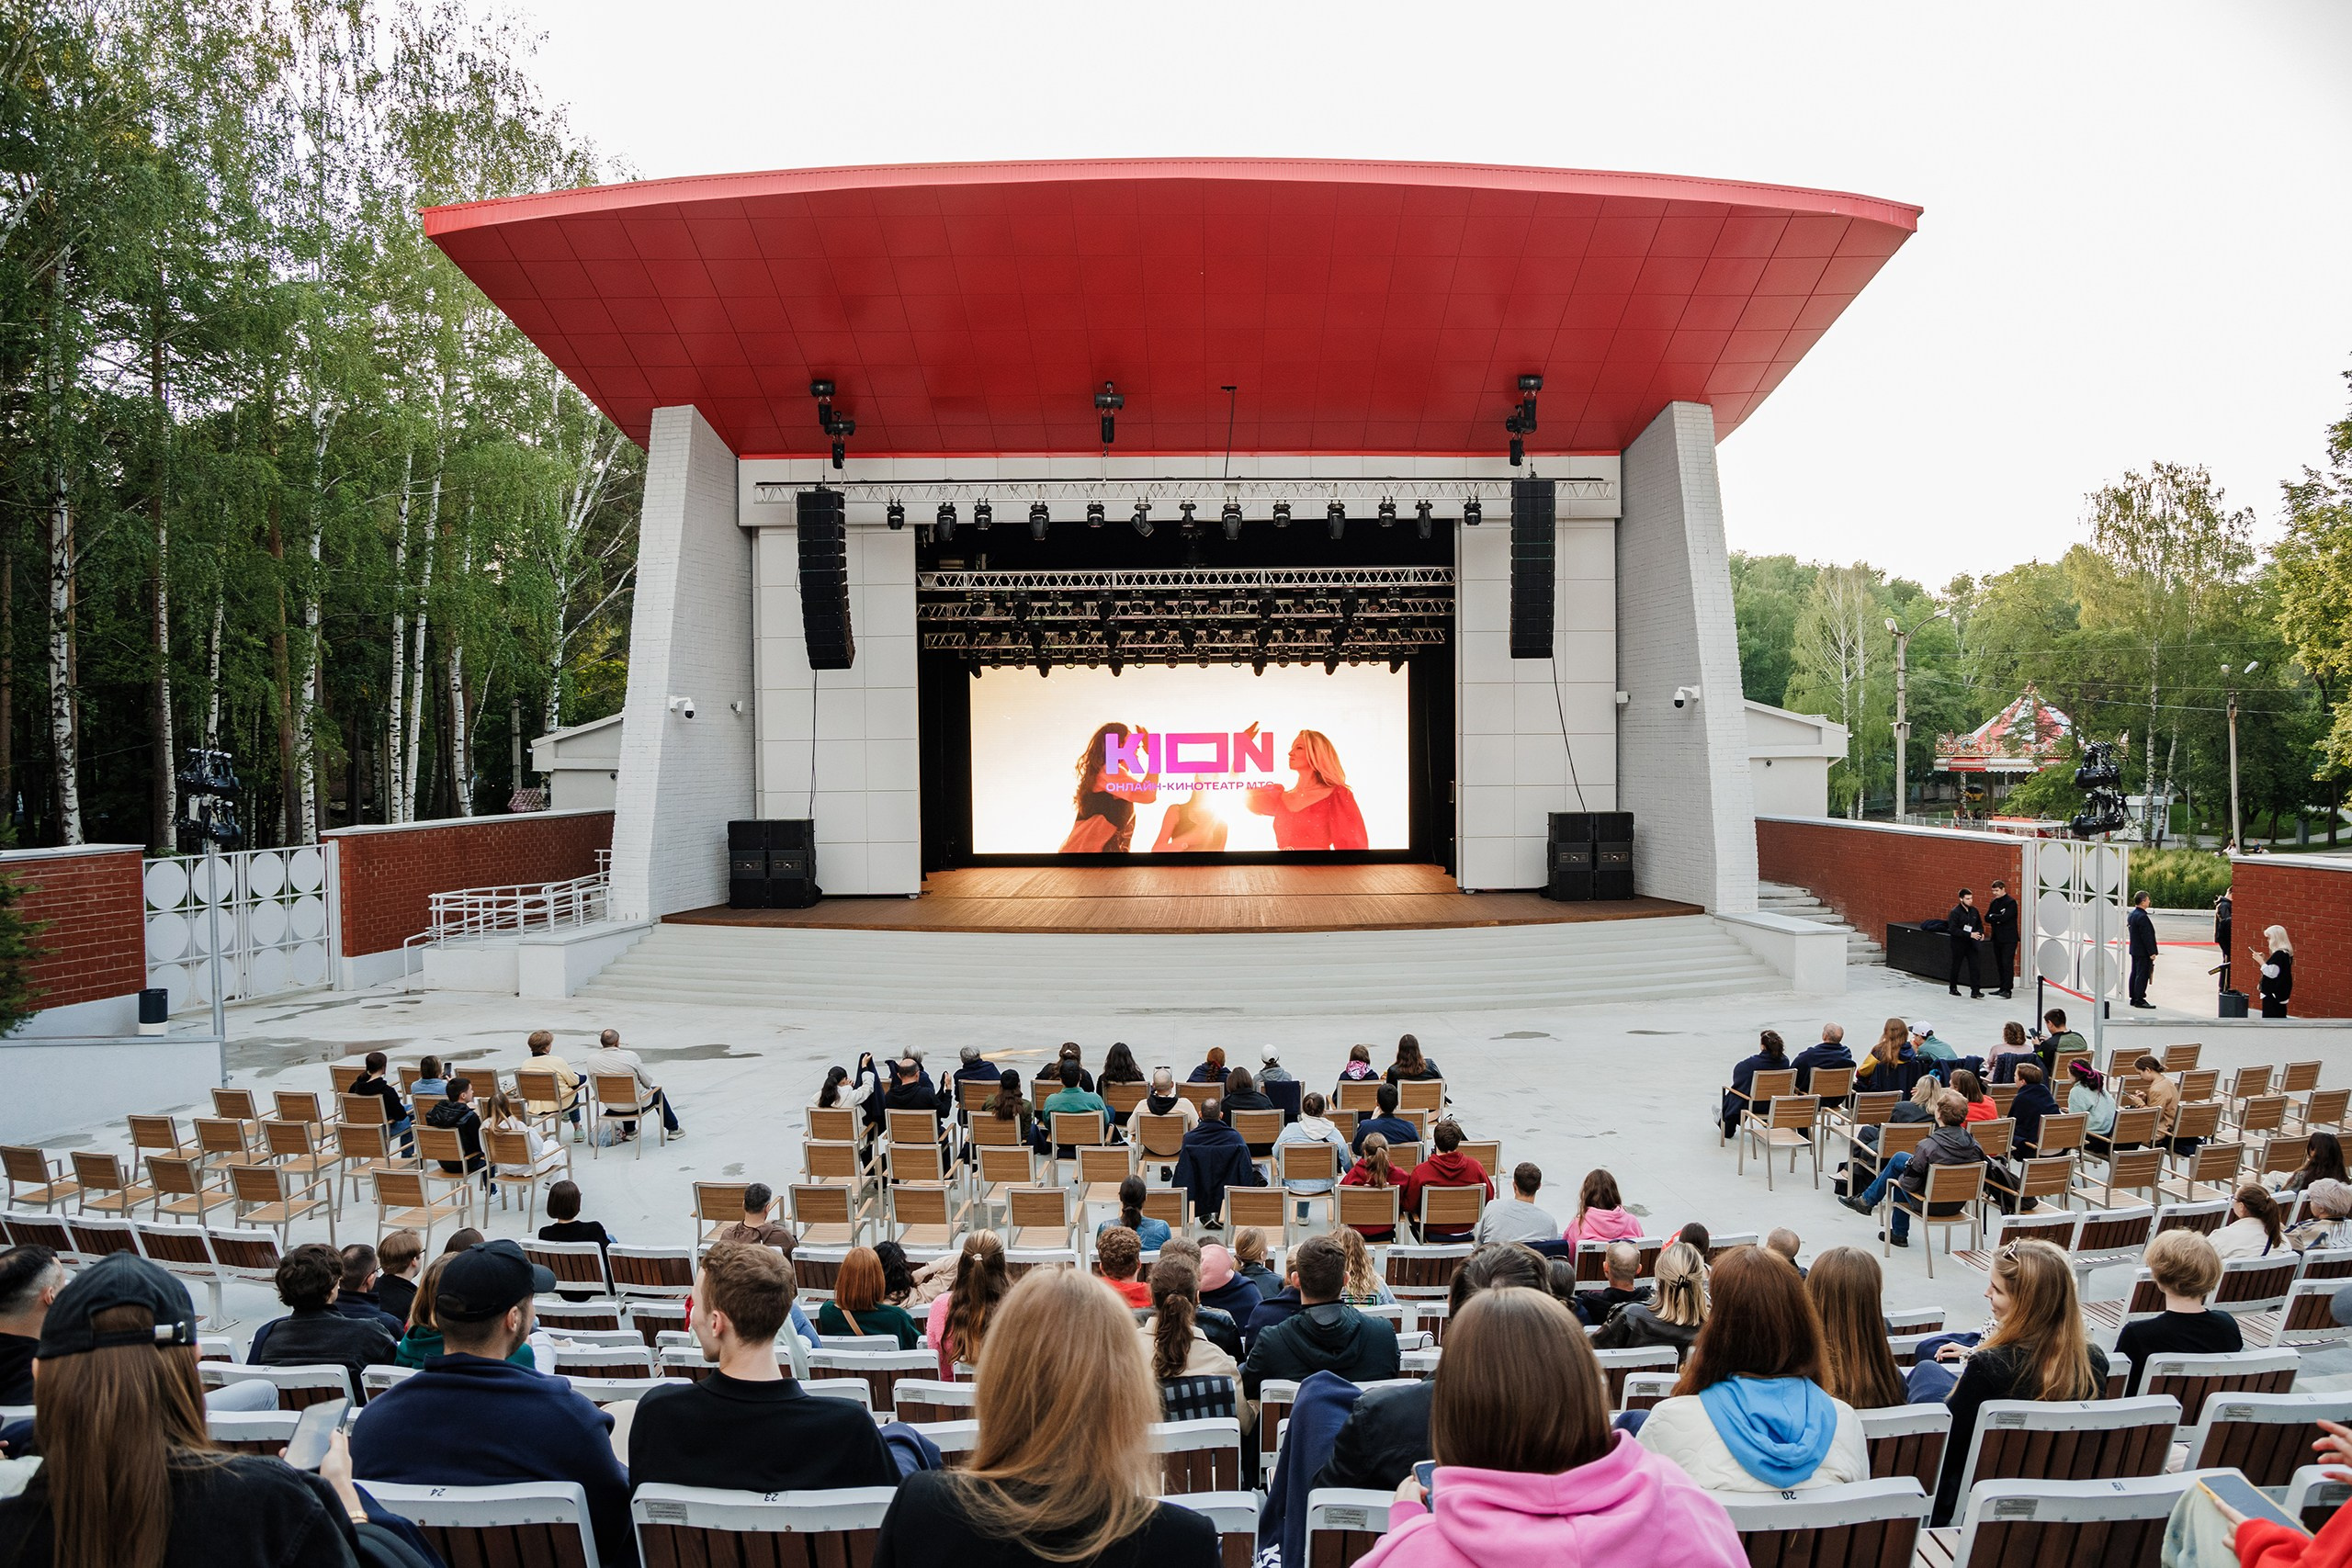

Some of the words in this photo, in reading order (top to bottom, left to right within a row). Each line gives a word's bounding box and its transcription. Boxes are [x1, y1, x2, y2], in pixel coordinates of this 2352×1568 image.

[1105, 732, 1274, 773] KION
[1105, 781, 1244, 792] ОНЛАЙН-КИНОТЕАТР
[430, 1487, 447, 1496] 24
[1781, 1491, 1797, 1500] 20
[763, 1493, 779, 1502] 23
